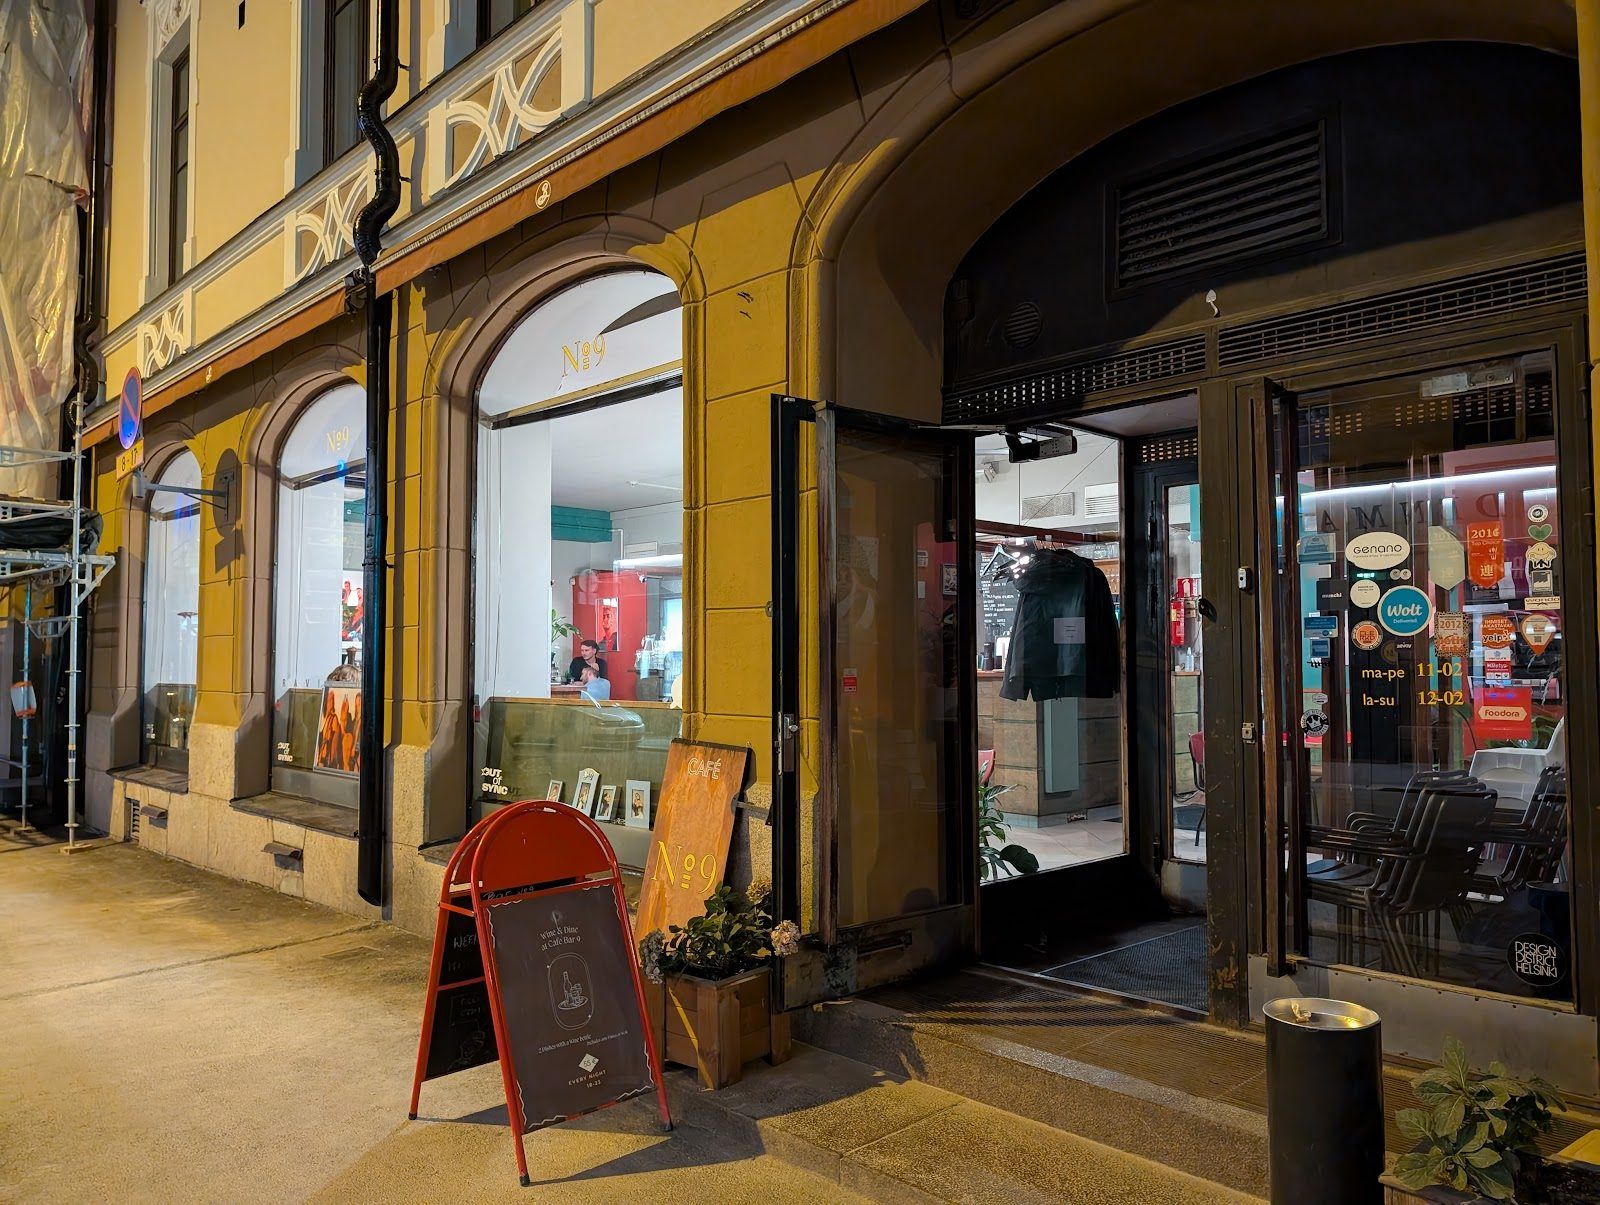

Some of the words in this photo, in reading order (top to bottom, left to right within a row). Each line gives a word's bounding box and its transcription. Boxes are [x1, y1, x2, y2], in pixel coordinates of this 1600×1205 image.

[1387, 603, 1423, 616] Wolt
[1439, 620, 1462, 629] 2012
[1482, 633, 1503, 643] yelp
[1361, 668, 1405, 681] ma-pe
[1417, 662, 1463, 677] 11-02
[1362, 693, 1395, 706] la-su
[1418, 691, 1465, 706] 12-02
[1484, 709, 1520, 717] foodora
[481, 767, 502, 777] OUT
[687, 758, 722, 780] CAFÉ
[492, 776, 502, 785] of
[481, 783, 509, 795] SYNC
[563, 936, 575, 944] Bar
[1515, 941, 1557, 957] DESIGN
[1515, 951, 1557, 967] DISTRICT
[1516, 962, 1558, 978] HELSINKI
[568, 1075, 587, 1086] EVERY
[588, 1069, 606, 1080] NIGHT
